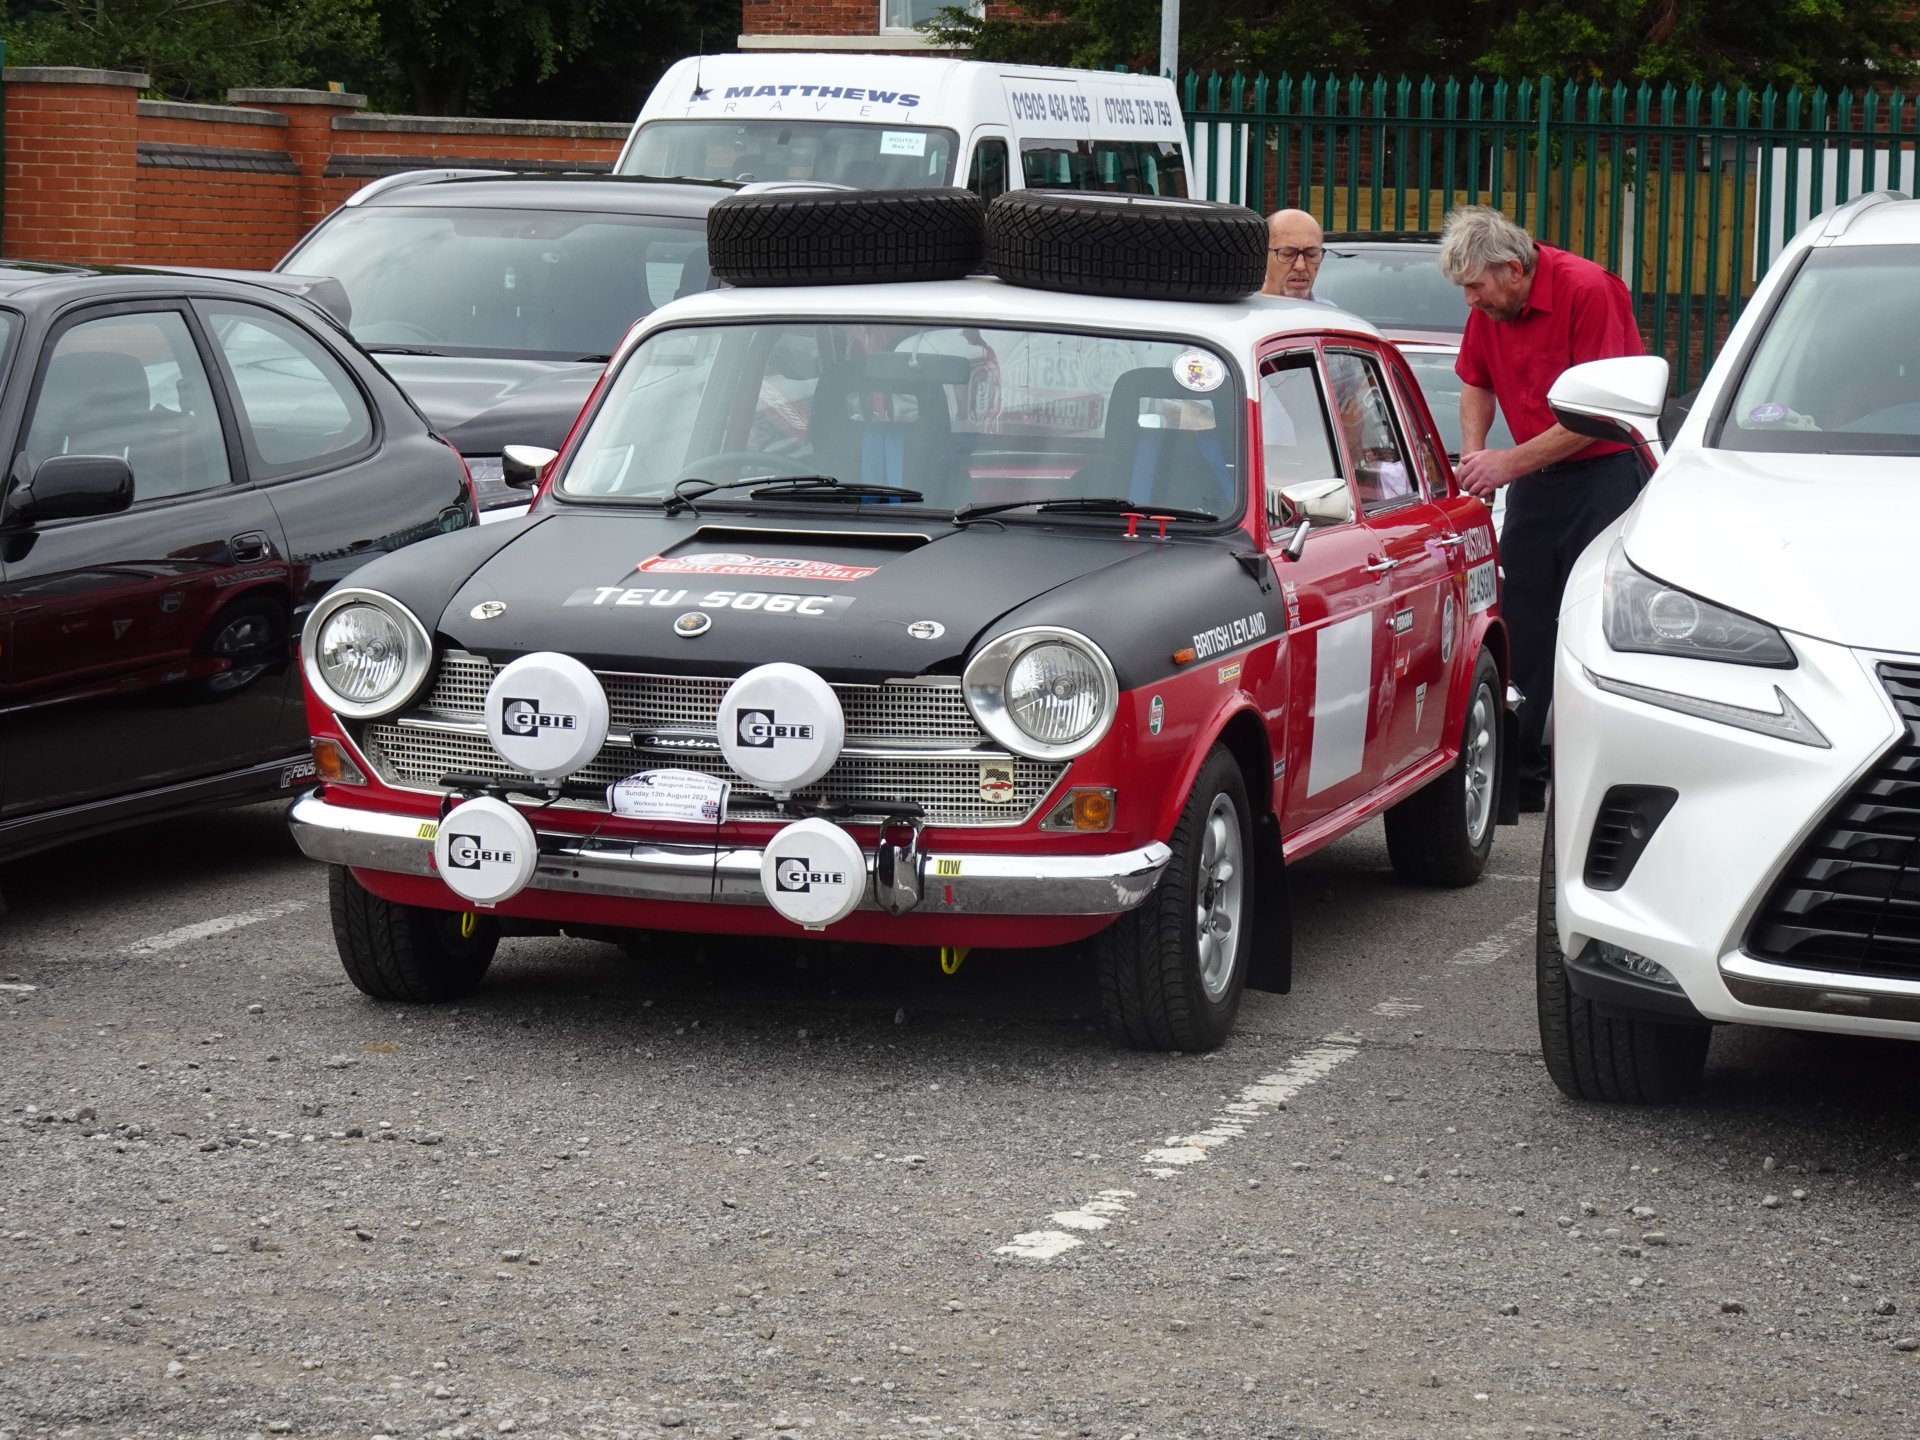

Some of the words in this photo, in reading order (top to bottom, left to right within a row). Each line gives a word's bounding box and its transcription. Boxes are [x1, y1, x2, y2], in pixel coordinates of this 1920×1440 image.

[724, 85, 921, 107] MATTHEWS
[684, 100, 915, 123] TRAVEL
[1012, 91, 1047, 120] 01909
[1048, 93, 1070, 122] 484
[1070, 95, 1091, 123] 605
[1104, 97, 1136, 125] 07903
[1135, 99, 1154, 126] 750
[1154, 101, 1173, 126] 759
[1462, 524, 1492, 563] AUSTRALIA
[754, 559, 804, 568] 225
[592, 586, 688, 606] TEU
[699, 591, 834, 615] 506C
[1193, 623, 1231, 658] BRITISH
[1228, 611, 1267, 646] LEYLAND
[625, 789, 649, 798] Sunday
[666, 792, 690, 801] August
[692, 793, 708, 801] 2023
[633, 800, 658, 808] Worksop
[665, 802, 697, 810] Ambergate
[418, 823, 438, 838] TOW
[938, 859, 962, 875] TOW
